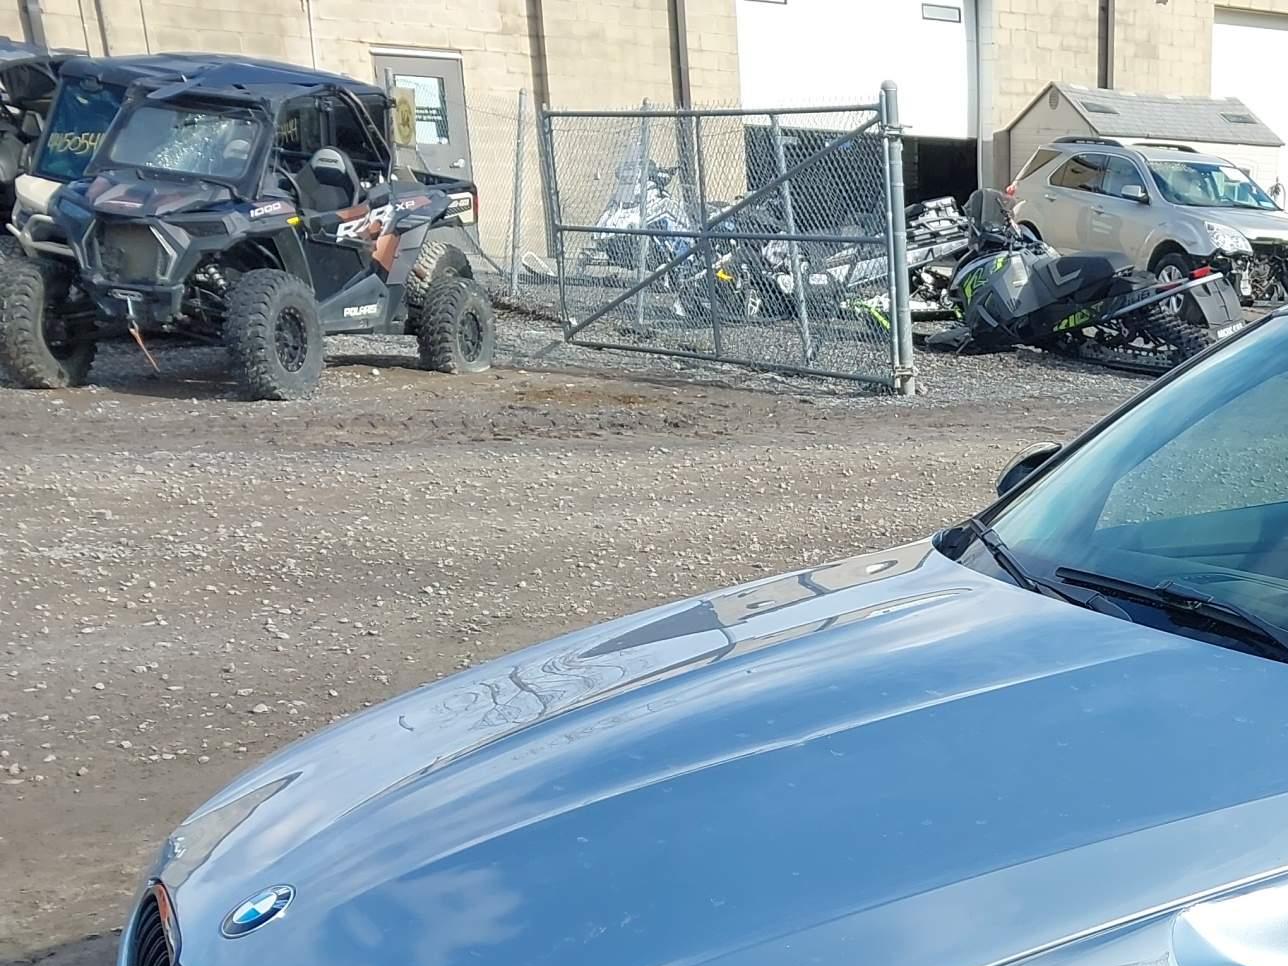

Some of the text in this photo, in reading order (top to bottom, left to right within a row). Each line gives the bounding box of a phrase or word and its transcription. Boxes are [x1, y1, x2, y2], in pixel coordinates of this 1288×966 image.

[250, 202, 281, 218] 1000
[395, 200, 416, 211] XP
[343, 303, 378, 317] POLARIS
